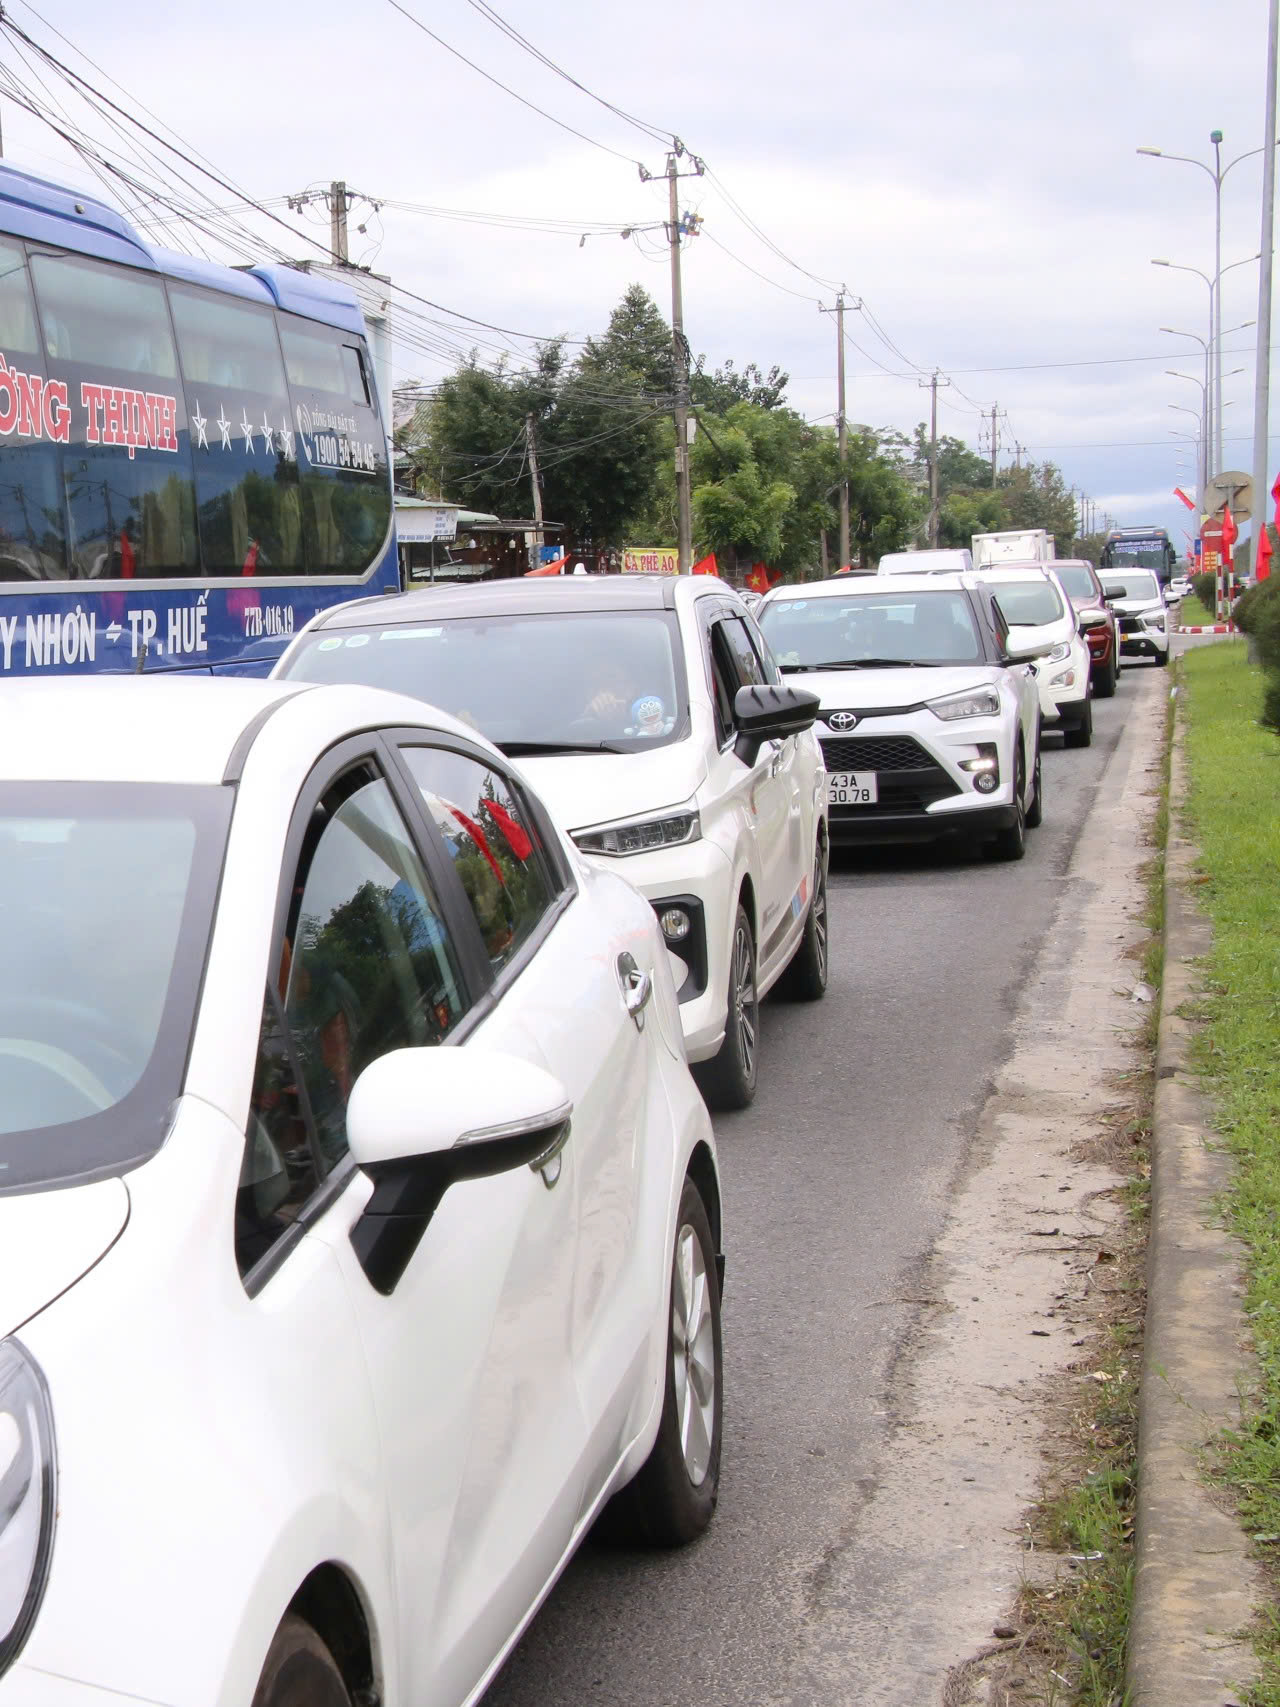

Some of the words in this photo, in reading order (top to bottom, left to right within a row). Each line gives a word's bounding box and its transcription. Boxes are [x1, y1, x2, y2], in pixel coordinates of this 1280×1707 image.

[80, 381, 178, 460] THỊNH
[313, 435, 338, 465] 1900
[338, 438, 351, 467] 54
[25, 604, 96, 667] NHƠN
[167, 589, 210, 655] HUẾ
[830, 774, 857, 788] 43A
